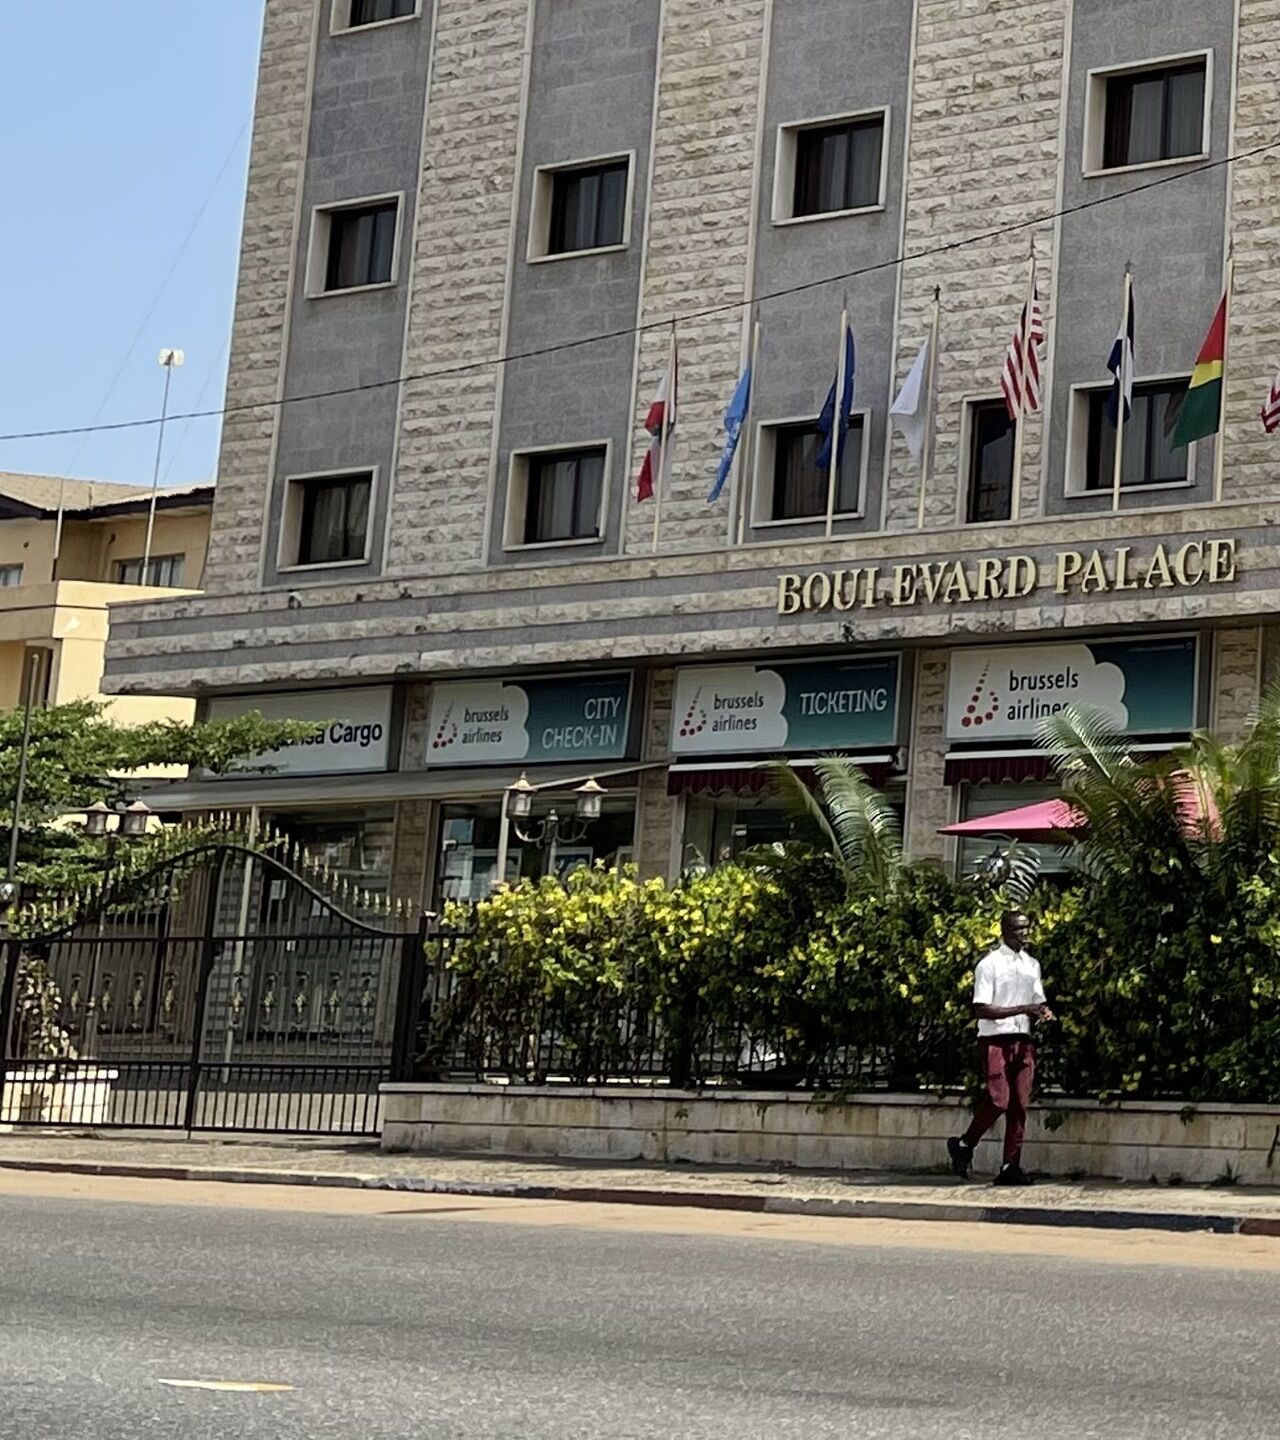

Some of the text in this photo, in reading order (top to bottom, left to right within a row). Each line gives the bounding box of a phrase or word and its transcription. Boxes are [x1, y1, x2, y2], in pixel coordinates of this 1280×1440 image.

[776, 538, 1238, 616] BOULEVARD PALACE
[1009, 667, 1079, 692] brussels
[584, 696, 622, 720] CITY
[714, 691, 765, 709] brussels
[800, 688, 888, 716] TICKETING
[464, 704, 509, 723] brussels
[712, 713, 758, 732] airlines
[329, 722, 383, 747] Cargo
[462, 726, 503, 744] airlines
[542, 724, 619, 749] CHECK-IN
